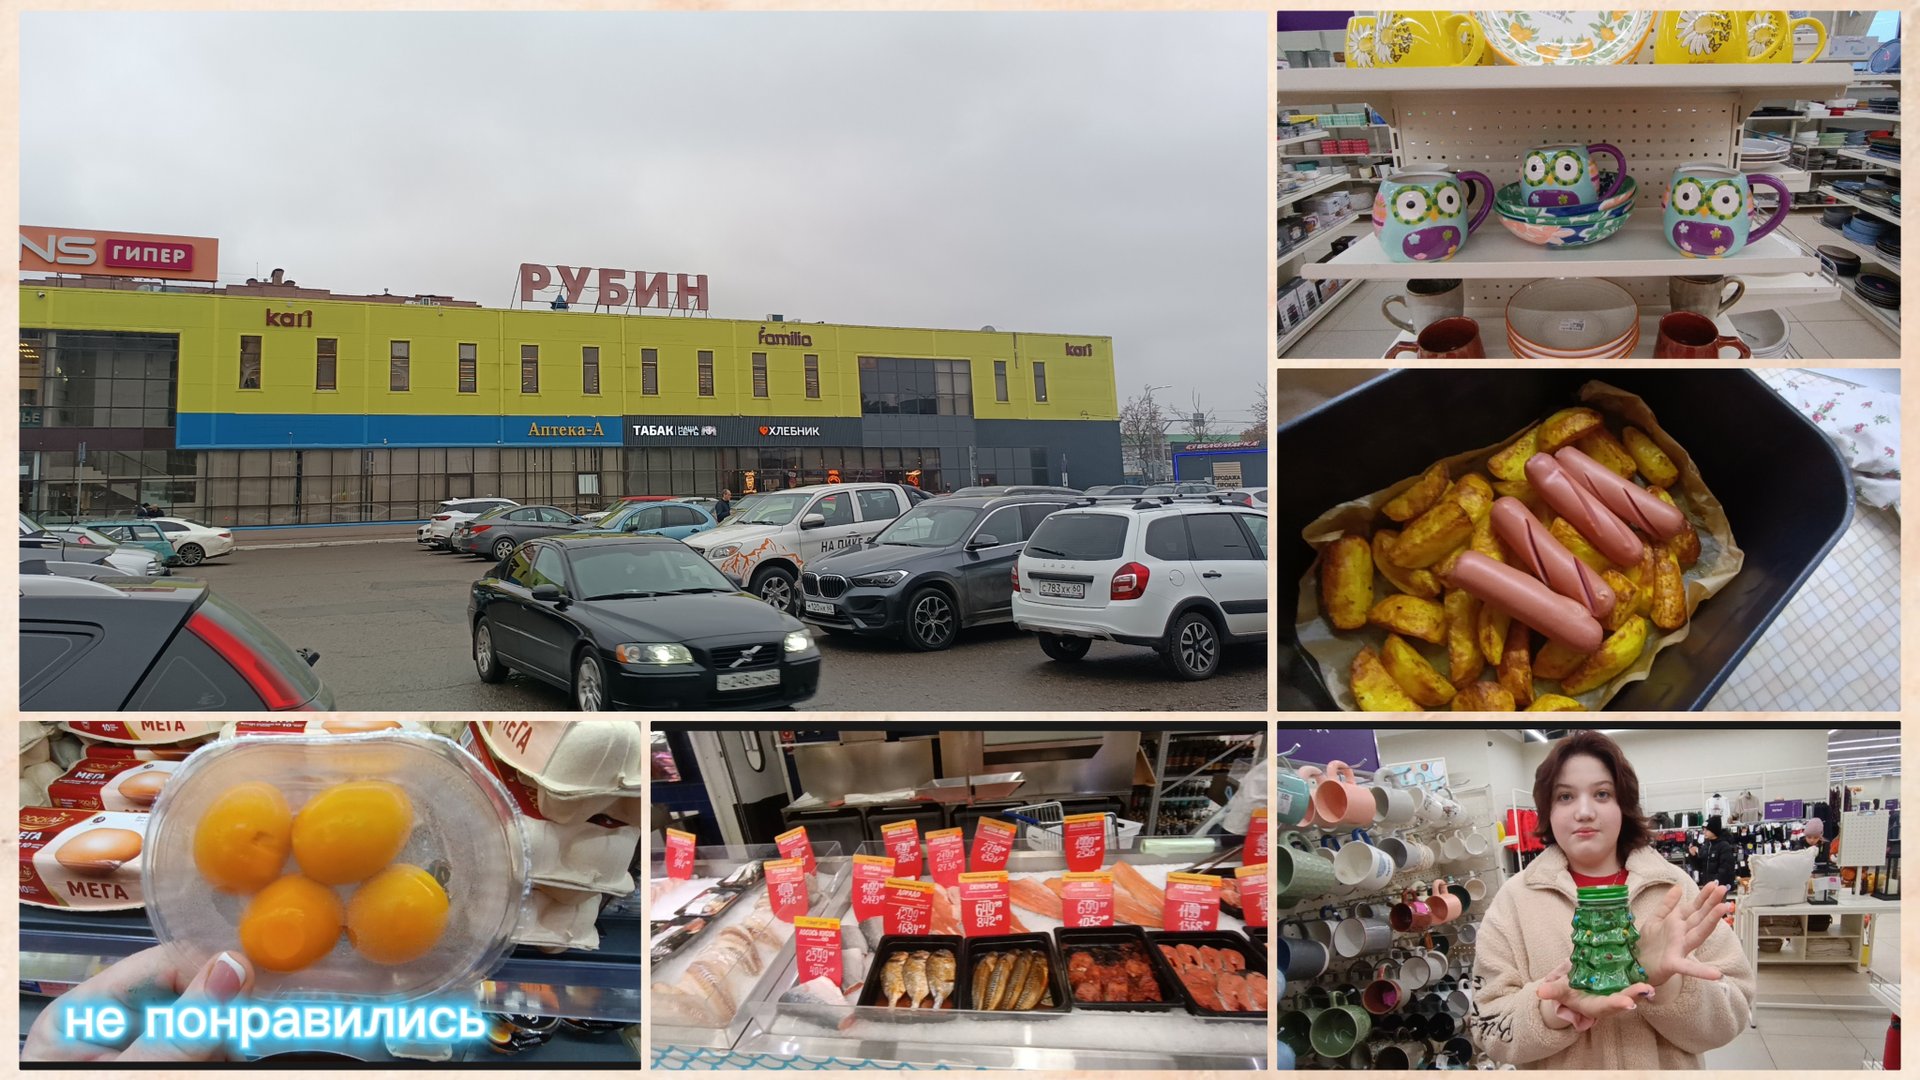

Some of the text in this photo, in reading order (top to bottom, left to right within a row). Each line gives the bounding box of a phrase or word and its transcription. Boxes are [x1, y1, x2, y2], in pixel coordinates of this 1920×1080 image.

[112, 245, 186, 264] ГИПЕР
[520, 263, 709, 311] РУБИН
[265, 307, 313, 329] kari
[758, 326, 813, 347] familia
[1065, 342, 1093, 357] kari
[528, 422, 604, 436] Аптека-А
[632, 425, 674, 436] ТАБАК
[768, 426, 820, 436] ХЛЕБНИК
[821, 540, 834, 552] НА
[75, 771, 106, 780] МЕГА
[66, 880, 130, 900] МЕГА
[1077, 900, 1099, 914] 699
[976, 916, 997, 928] 842
